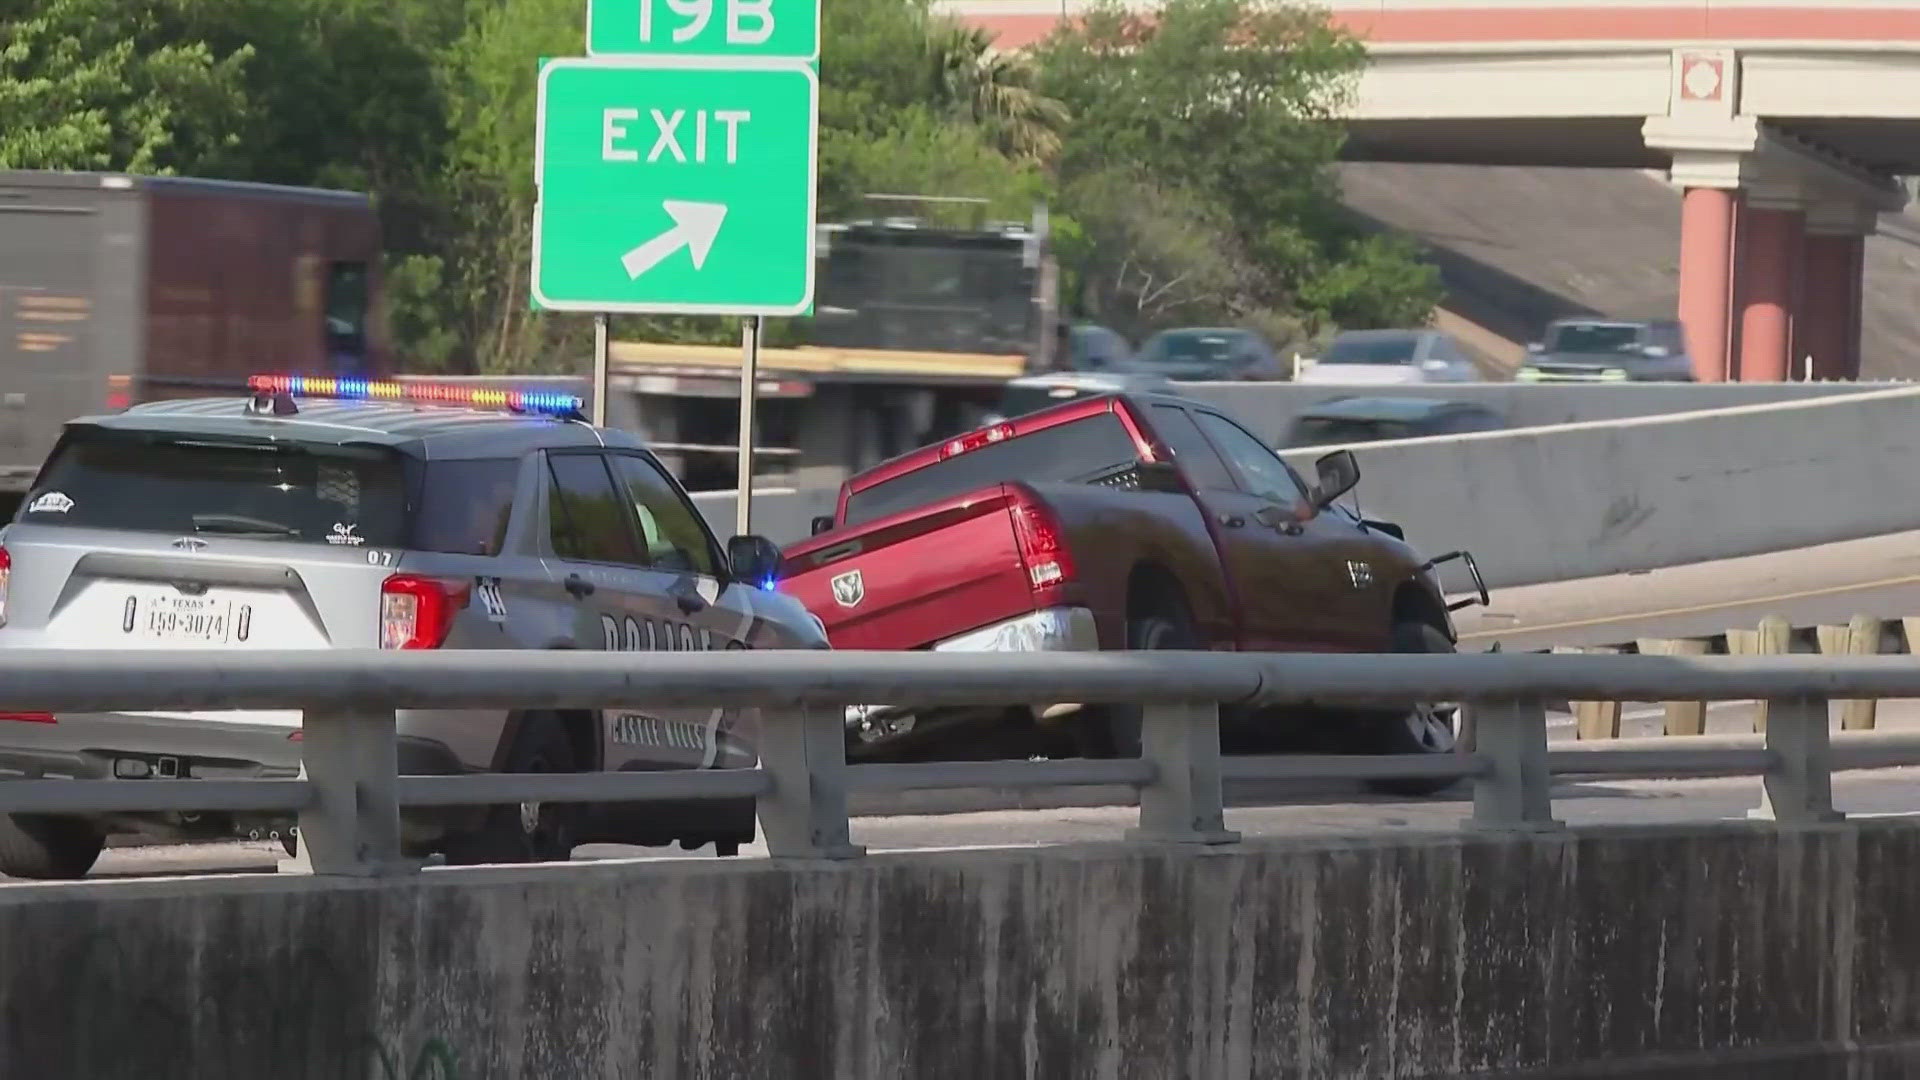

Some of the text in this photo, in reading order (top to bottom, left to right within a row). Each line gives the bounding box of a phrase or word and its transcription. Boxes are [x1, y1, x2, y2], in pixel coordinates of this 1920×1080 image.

[639, 0, 775, 44] 19B
[602, 108, 750, 164] EXIT
[367, 551, 392, 567] 07
[172, 599, 204, 608] TEXAS
